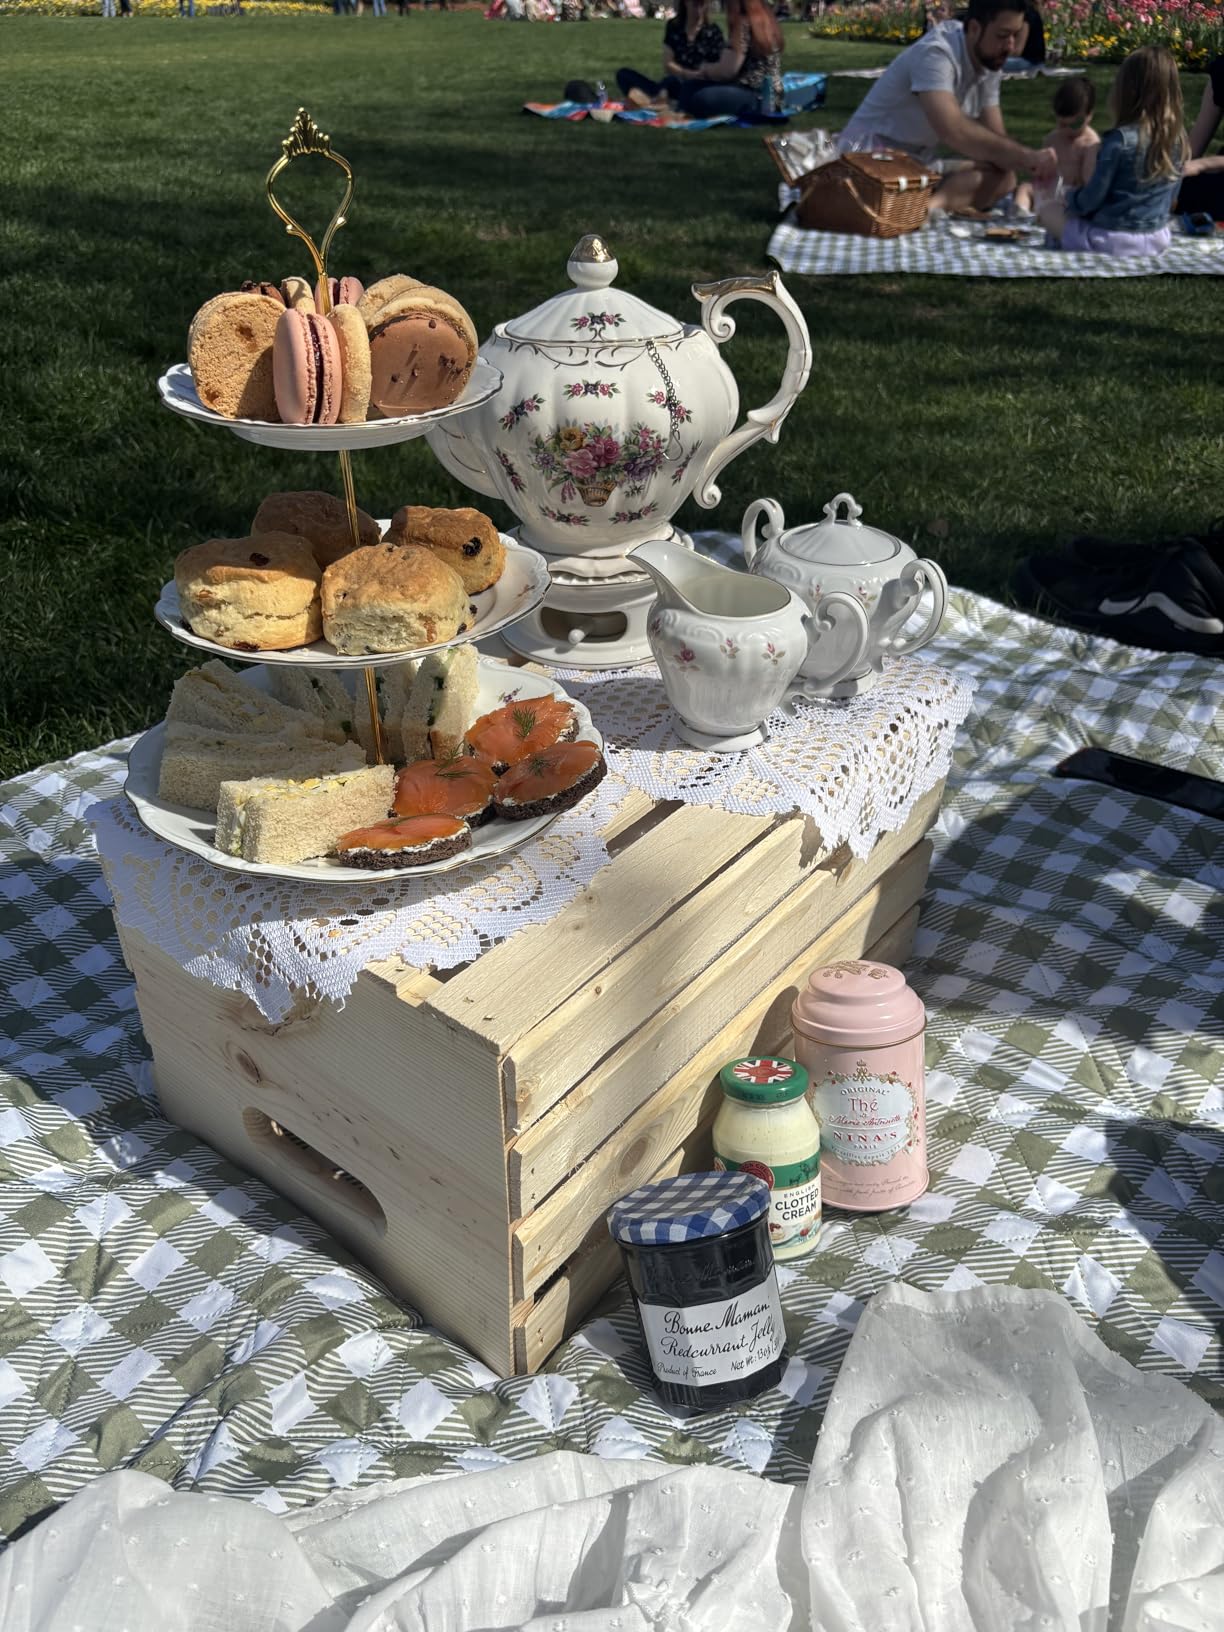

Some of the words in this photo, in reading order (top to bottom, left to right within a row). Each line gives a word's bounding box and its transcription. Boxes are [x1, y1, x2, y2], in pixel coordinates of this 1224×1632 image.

[847, 1097, 879, 1112] Thé
[833, 1130, 897, 1142] NINA'S
[775, 1188, 819, 1211] CLOTTED
[783, 1184, 816, 1198] ENGLISH
[782, 1200, 817, 1221] CREAM
[663, 1310, 713, 1335] Bonne
[714, 1300, 770, 1330] Maman
[660, 1334, 749, 1358] Redcurrant
[748, 1313, 775, 1353] Jelly
[656, 1361, 680, 1375] Product
[682, 1366, 689, 1380] of
[691, 1366, 717, 1378] France
[730, 1360, 745, 1372] Net
